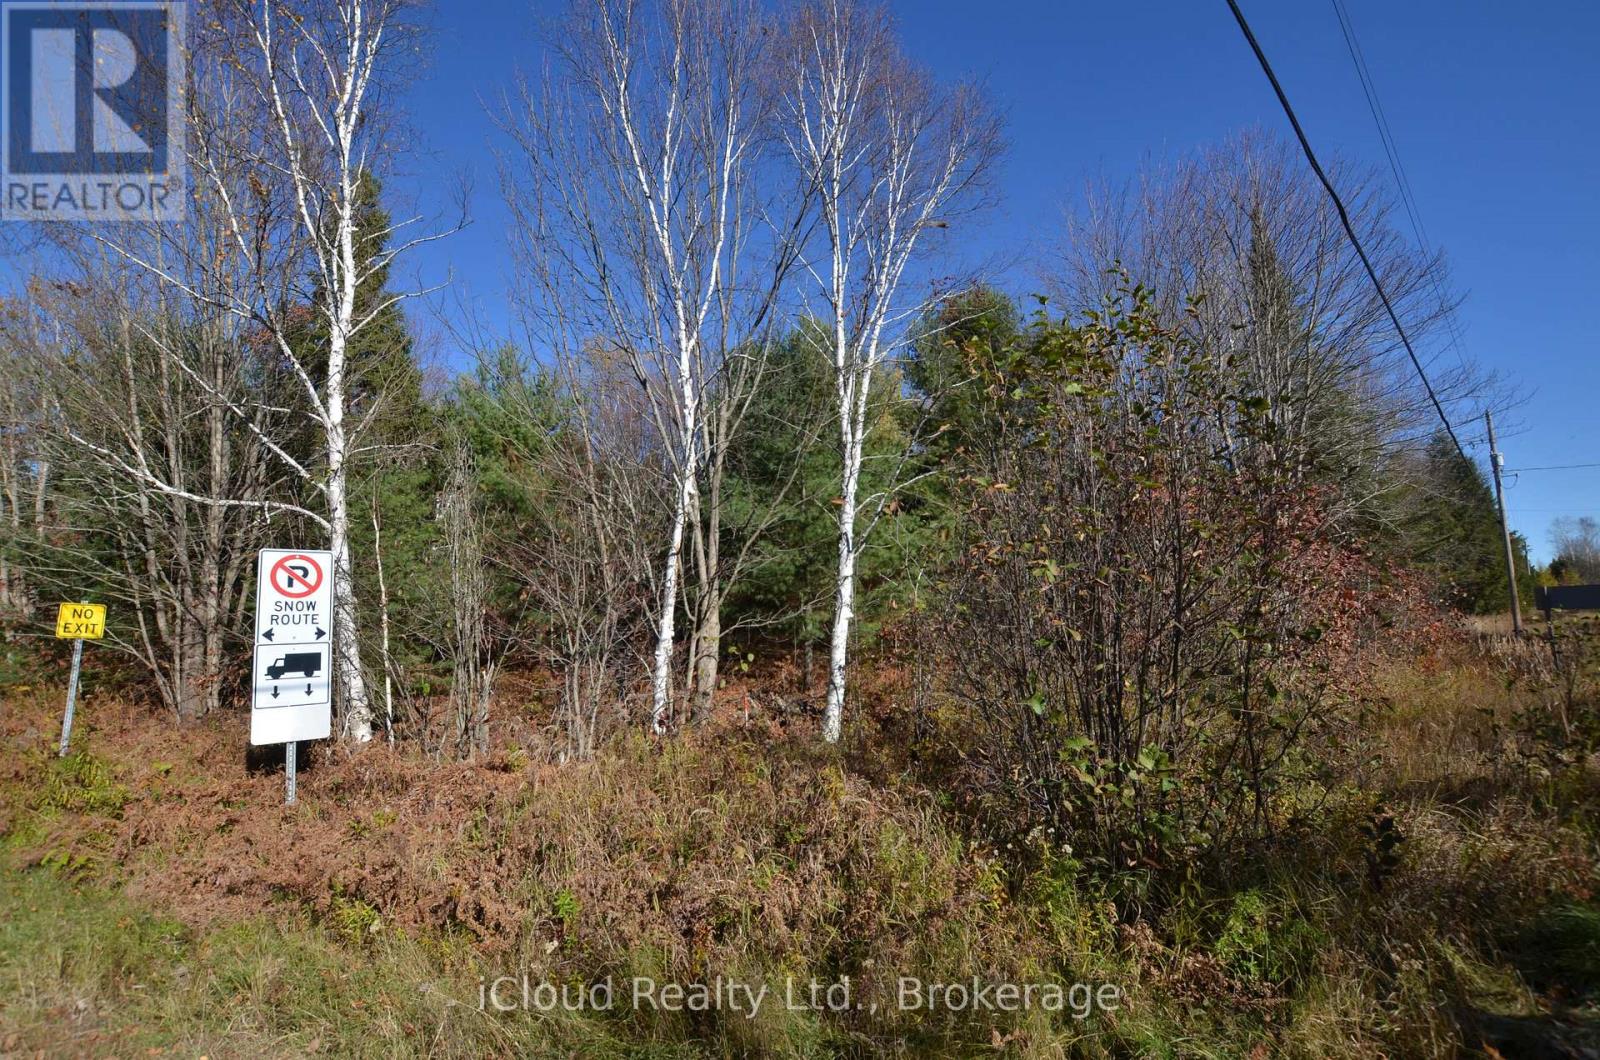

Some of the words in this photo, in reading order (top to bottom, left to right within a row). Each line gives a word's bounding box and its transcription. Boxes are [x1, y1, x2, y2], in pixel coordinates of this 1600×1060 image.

[274, 600, 317, 612] SNOW
[72, 608, 94, 620] NO
[270, 613, 320, 625] ROUTE
[63, 622, 99, 634] EXIT
